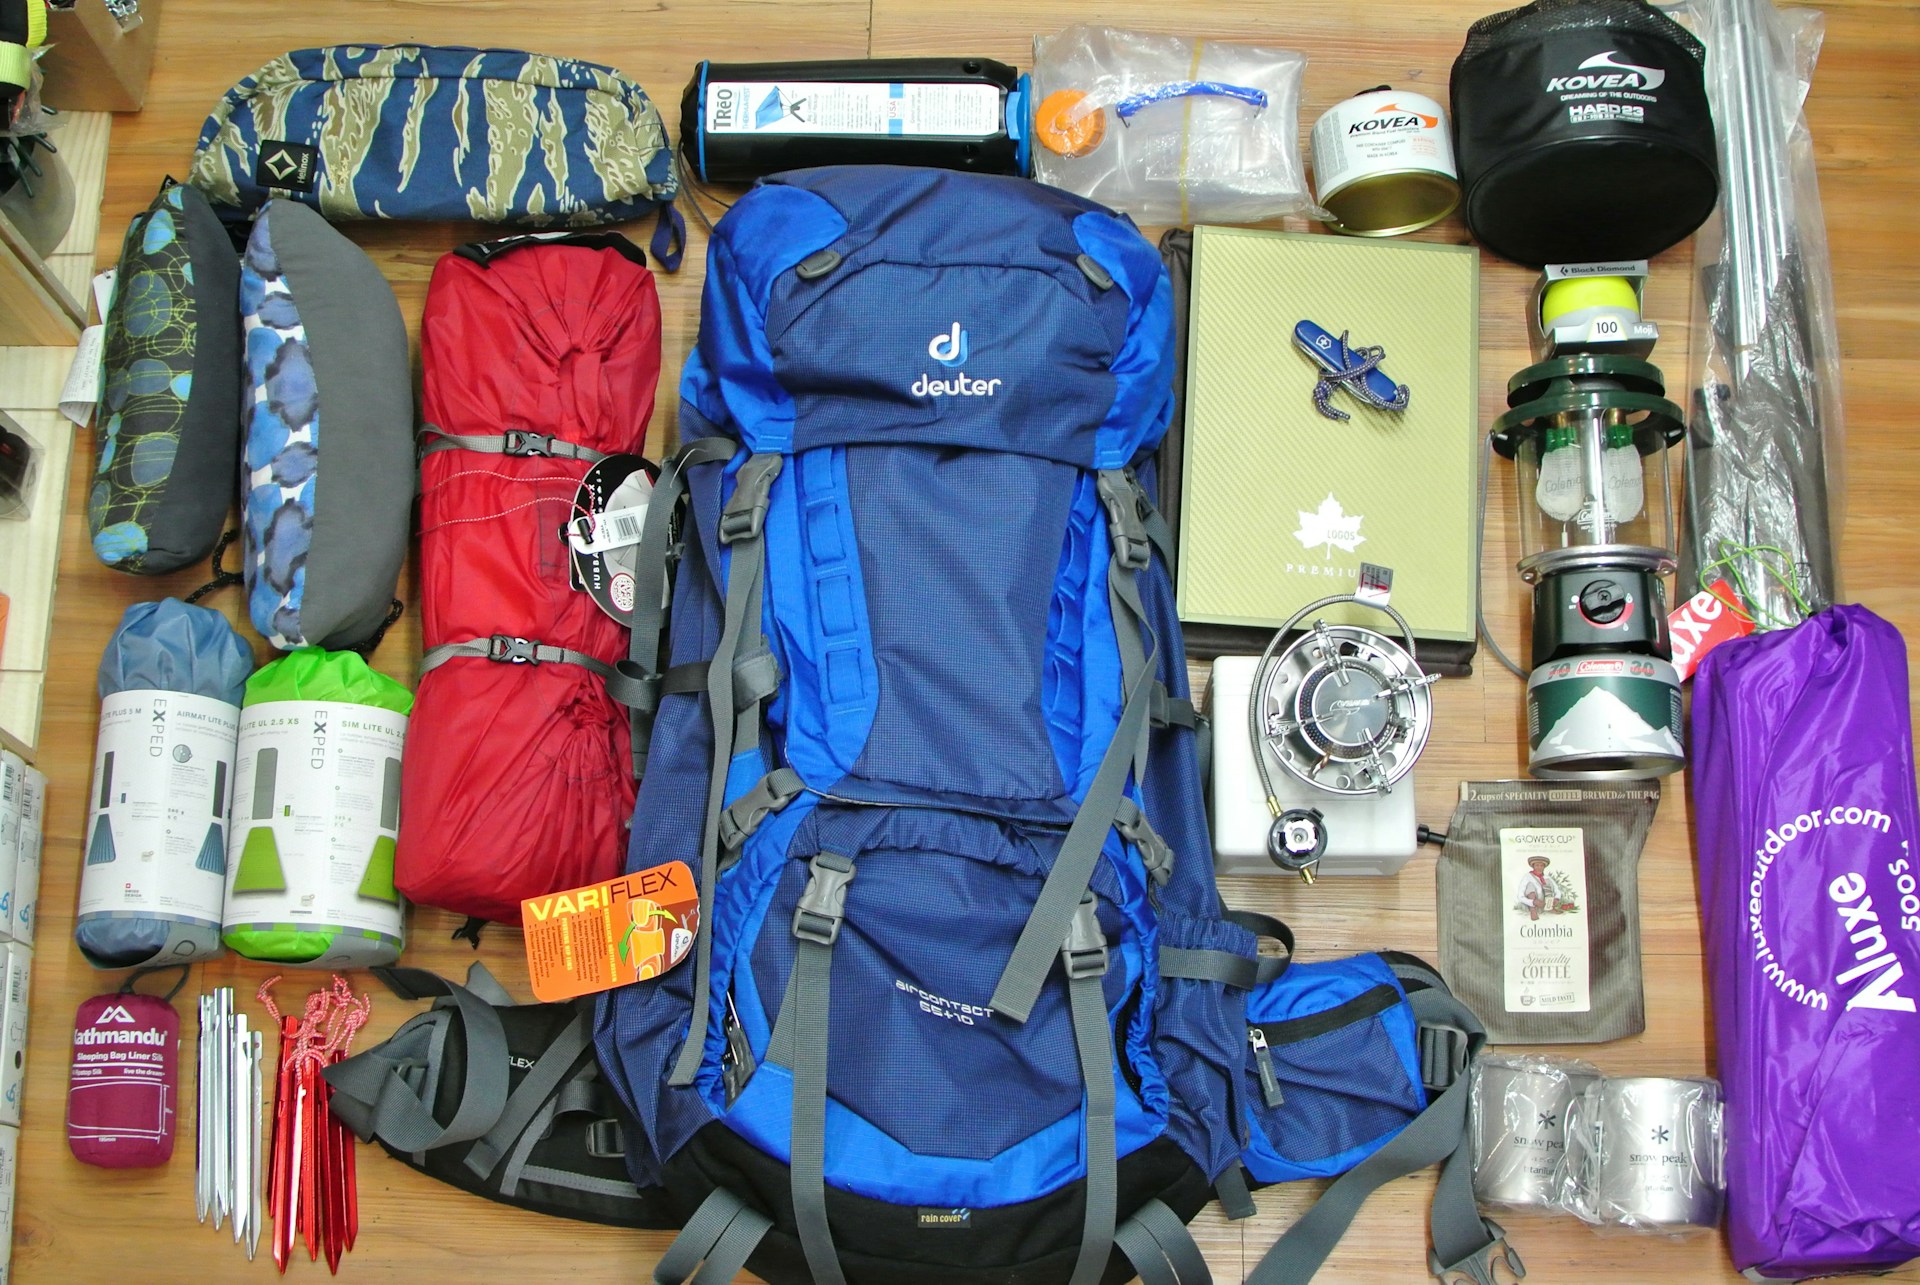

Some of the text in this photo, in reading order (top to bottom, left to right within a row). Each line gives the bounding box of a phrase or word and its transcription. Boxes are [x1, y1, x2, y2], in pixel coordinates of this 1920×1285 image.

[1546, 73, 1639, 92] KOVEA
[1560, 92, 1598, 102] DREAMING
[1623, 92, 1657, 103] OUTDOORS
[889, 101, 897, 118] USA
[1348, 116, 1419, 135] KOVEA
[296, 153, 309, 184] Helinox
[1596, 321, 1618, 334] 100
[1633, 325, 1653, 335] Moji
[911, 372, 1002, 397] deuter
[1326, 529, 1356, 541] LOGOS
[1286, 563, 1357, 578] PREMIU
[1669, 591, 1723, 665] uxe
[1580, 661, 1616, 672] Coleman
[176, 710, 206, 721] AIRMAT
[208, 716, 222, 726] LITE
[271, 718, 284, 726] 2.5
[149, 698, 167, 757] EXPED
[341, 720, 360, 729] SIM
[363, 723, 382, 733] LITE
[311, 710, 328, 770] EXPED
[1470, 789, 1477, 801] 2
[1477, 793, 1496, 803] cups
[1505, 790, 1547, 801] SPECIALTY
[1582, 790, 1617, 800] BREWED
[1626, 790, 1643, 800] THE
[1750, 806, 1891, 1011] www.luxeoutdoor.com
[1520, 924, 1573, 938] Colombia
[1522, 965, 1571, 979] COFFEE
[74, 1027, 165, 1046] athmandu
[77, 1051, 163, 1062] Sleeping Bag Liner Silk
[509, 1055, 535, 1069] LEX
[1546, 1140, 1564, 1151] pea
[1630, 1152, 1688, 1166] snow peak
[921, 1213, 962, 1223] rain cover
